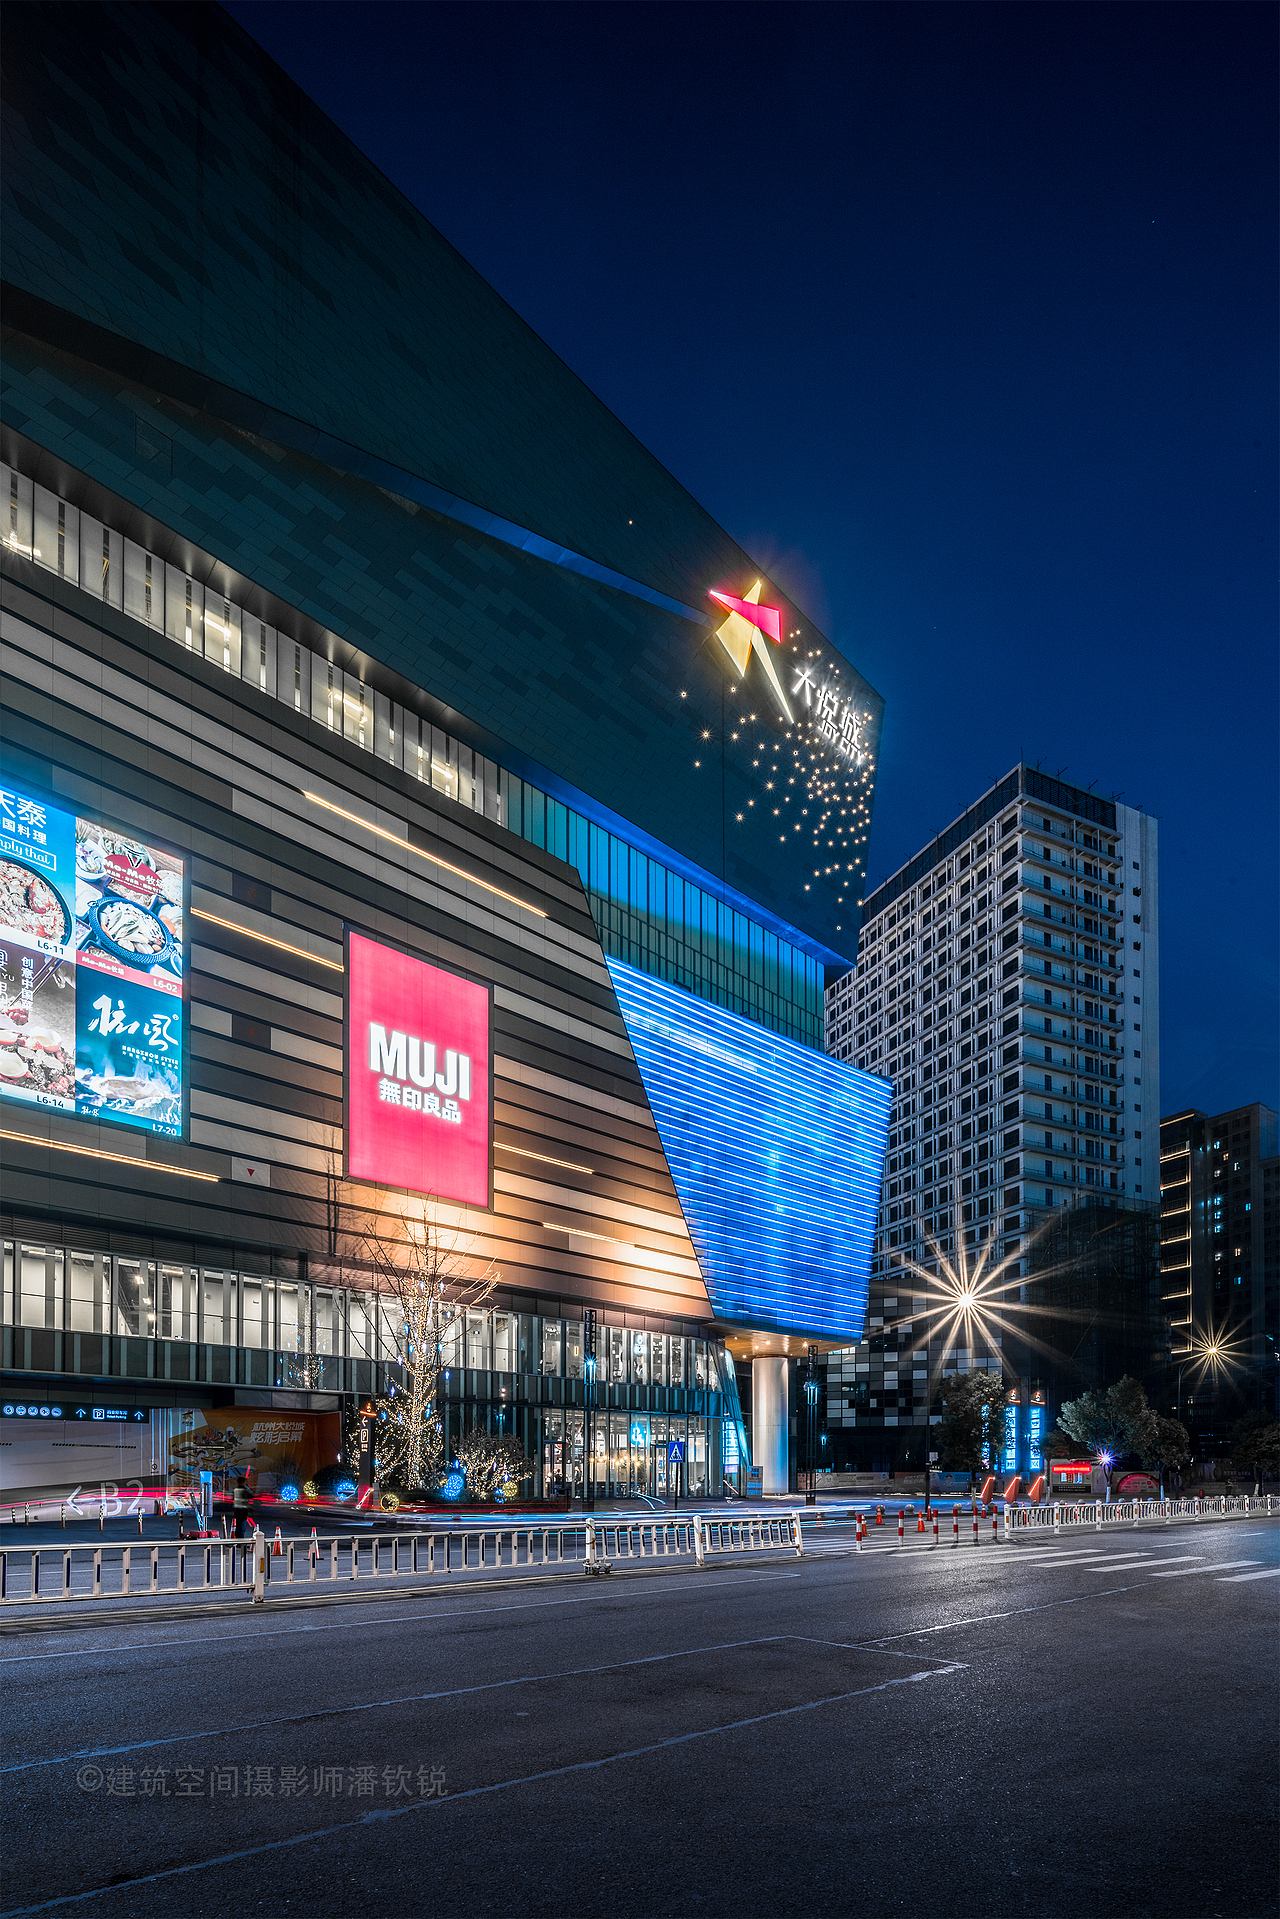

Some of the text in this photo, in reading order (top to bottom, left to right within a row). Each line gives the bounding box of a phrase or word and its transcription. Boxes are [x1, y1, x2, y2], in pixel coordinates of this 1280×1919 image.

[792, 667, 861, 750] 大悦城
[818, 720, 865, 765] JOY CITY
[0, 816, 47, 846] 国料理
[25, 845, 51, 865] thai
[37, 940, 64, 956] L6-11
[153, 978, 178, 993] L6-02
[369, 1022, 471, 1101] MUJI
[36, 1094, 64, 1109] L6-14
[379, 1077, 462, 1125] 無印良品
[152, 1123, 178, 1137] L7-20
[252, 1421, 305, 1431] 杭州大悦城
[100, 1479, 146, 1518] B2
